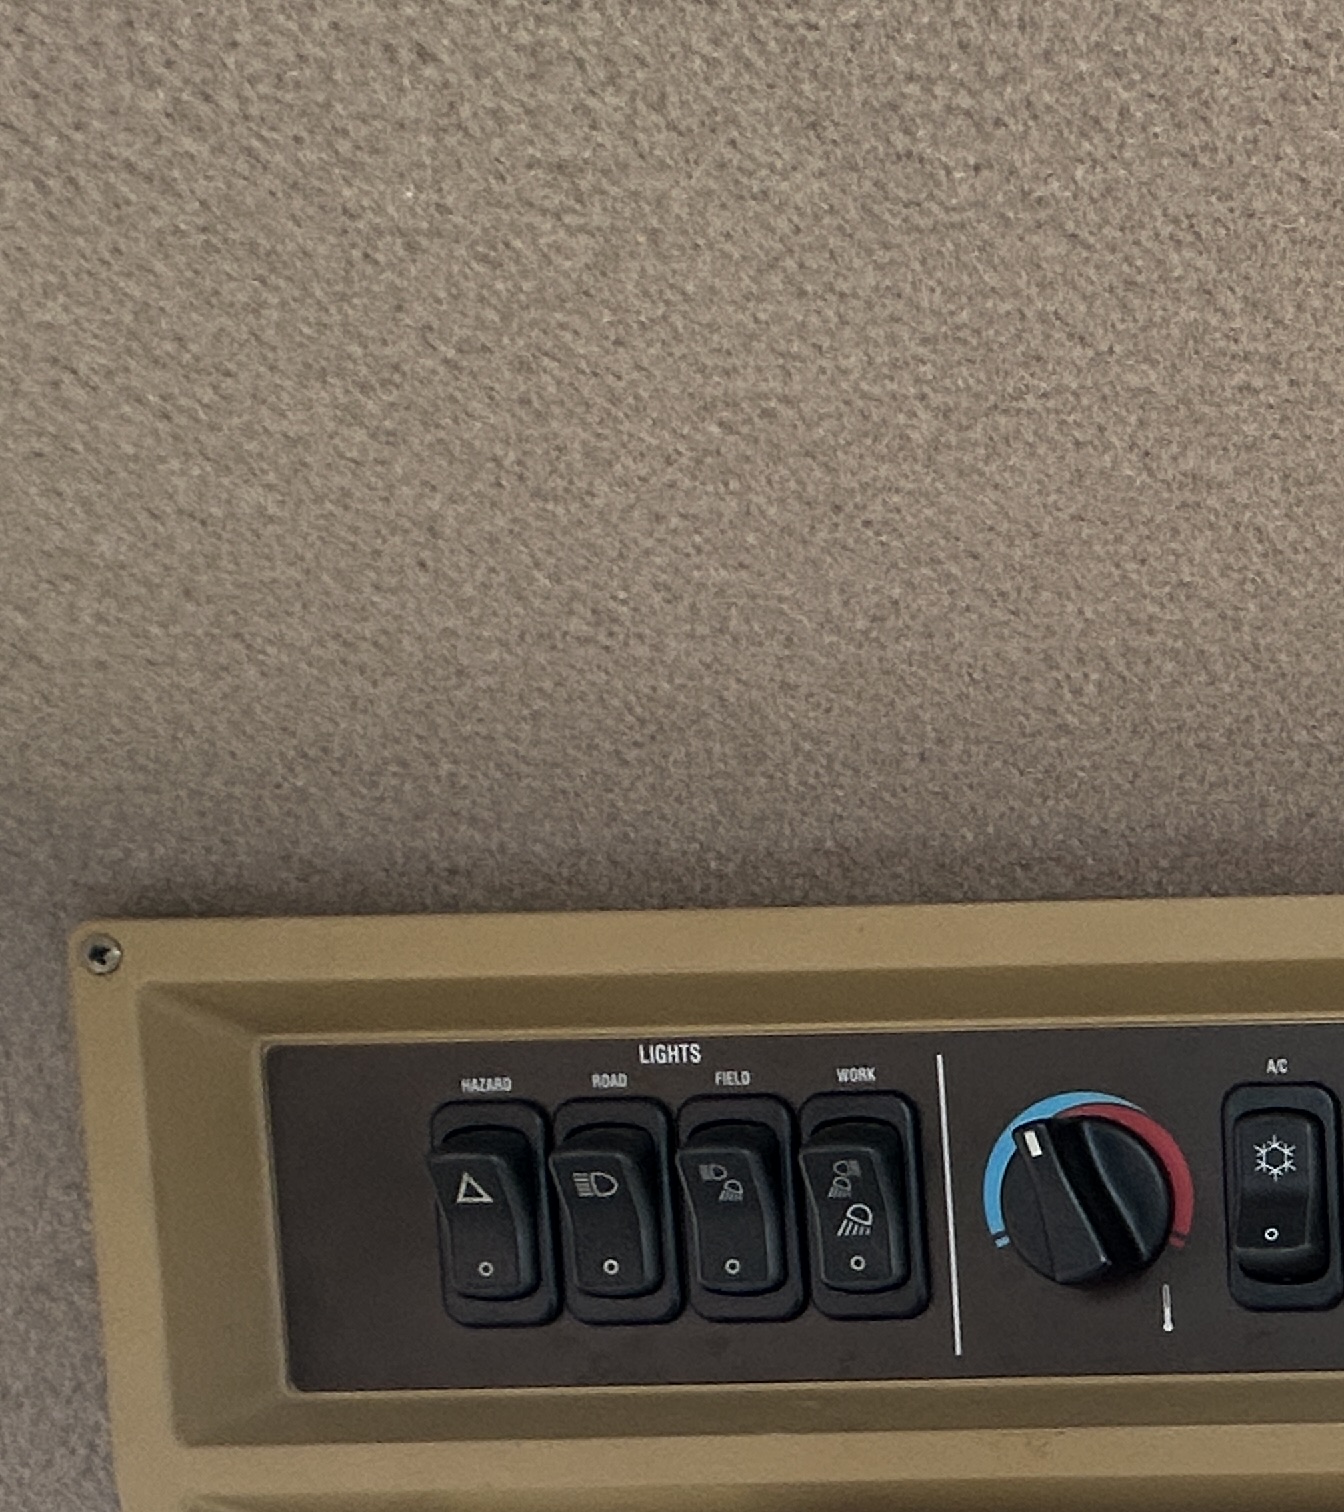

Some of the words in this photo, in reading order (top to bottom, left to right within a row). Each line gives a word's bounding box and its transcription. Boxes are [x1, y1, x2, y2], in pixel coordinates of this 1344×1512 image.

[639, 1044, 701, 1064] LIGHTS
[1266, 1059, 1288, 1074] A/C
[592, 1074, 628, 1088] ROAD
[715, 1071, 750, 1085] FIELD
[837, 1068, 876, 1082] WORK
[461, 1077, 512, 1092] HAZARD
